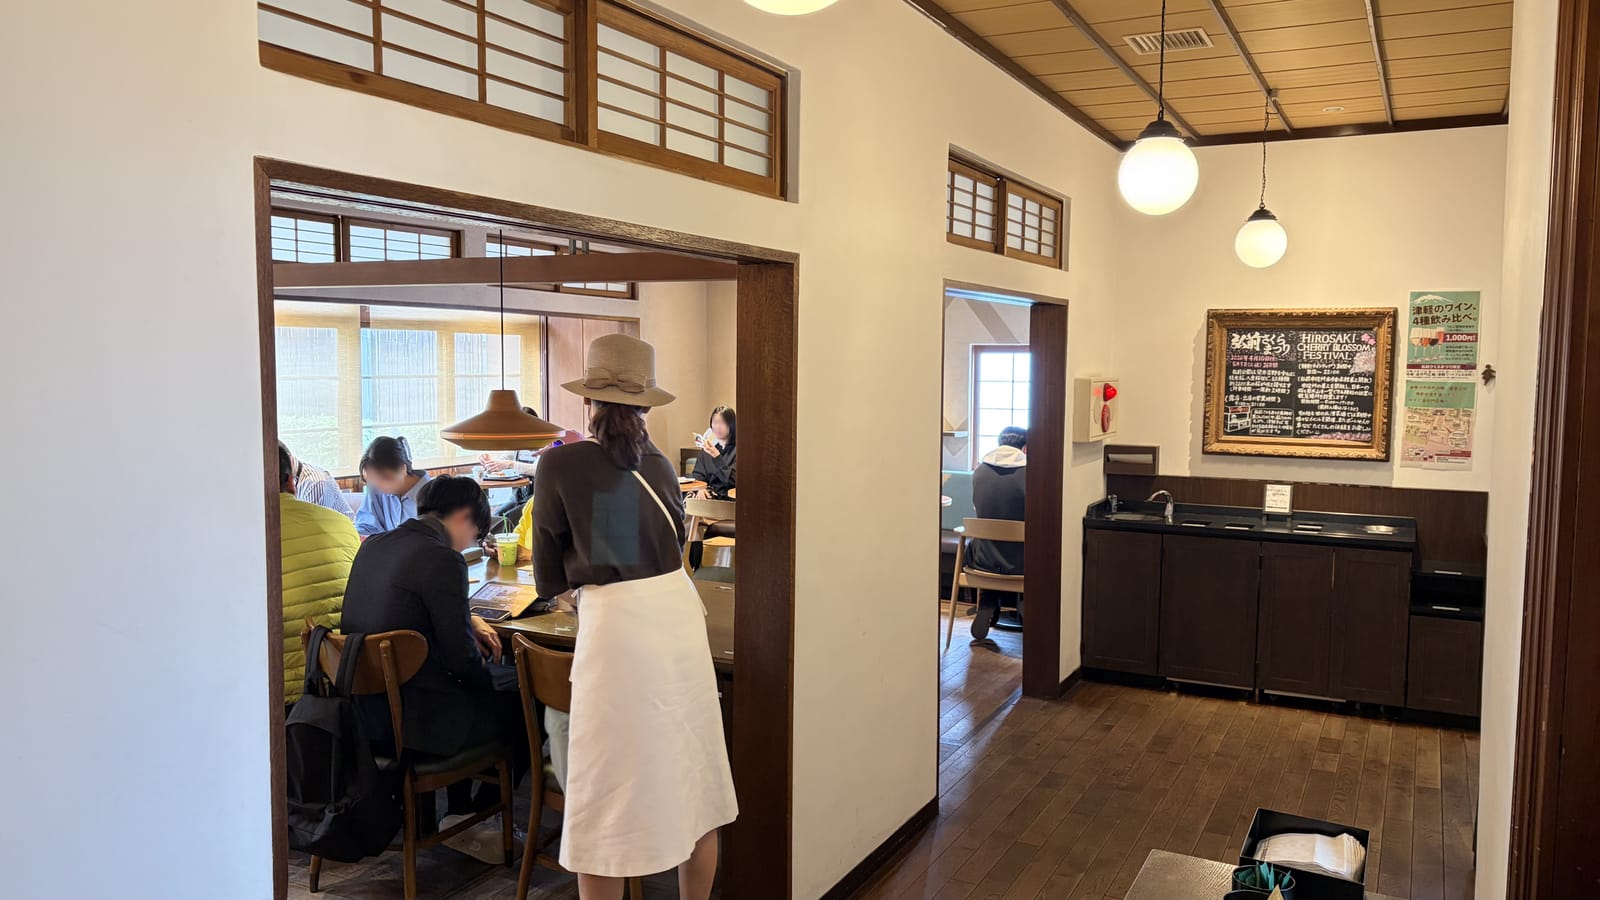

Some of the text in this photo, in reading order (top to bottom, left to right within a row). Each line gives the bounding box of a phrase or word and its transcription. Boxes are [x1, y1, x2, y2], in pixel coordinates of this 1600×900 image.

[1412, 313, 1477, 326] 4種飲み比べ。
[1302, 333, 1356, 343] HIROSAKI
[1296, 343, 1371, 352] CHERRY BLOSSOM
[1302, 351, 1352, 360] FESTIVAL
